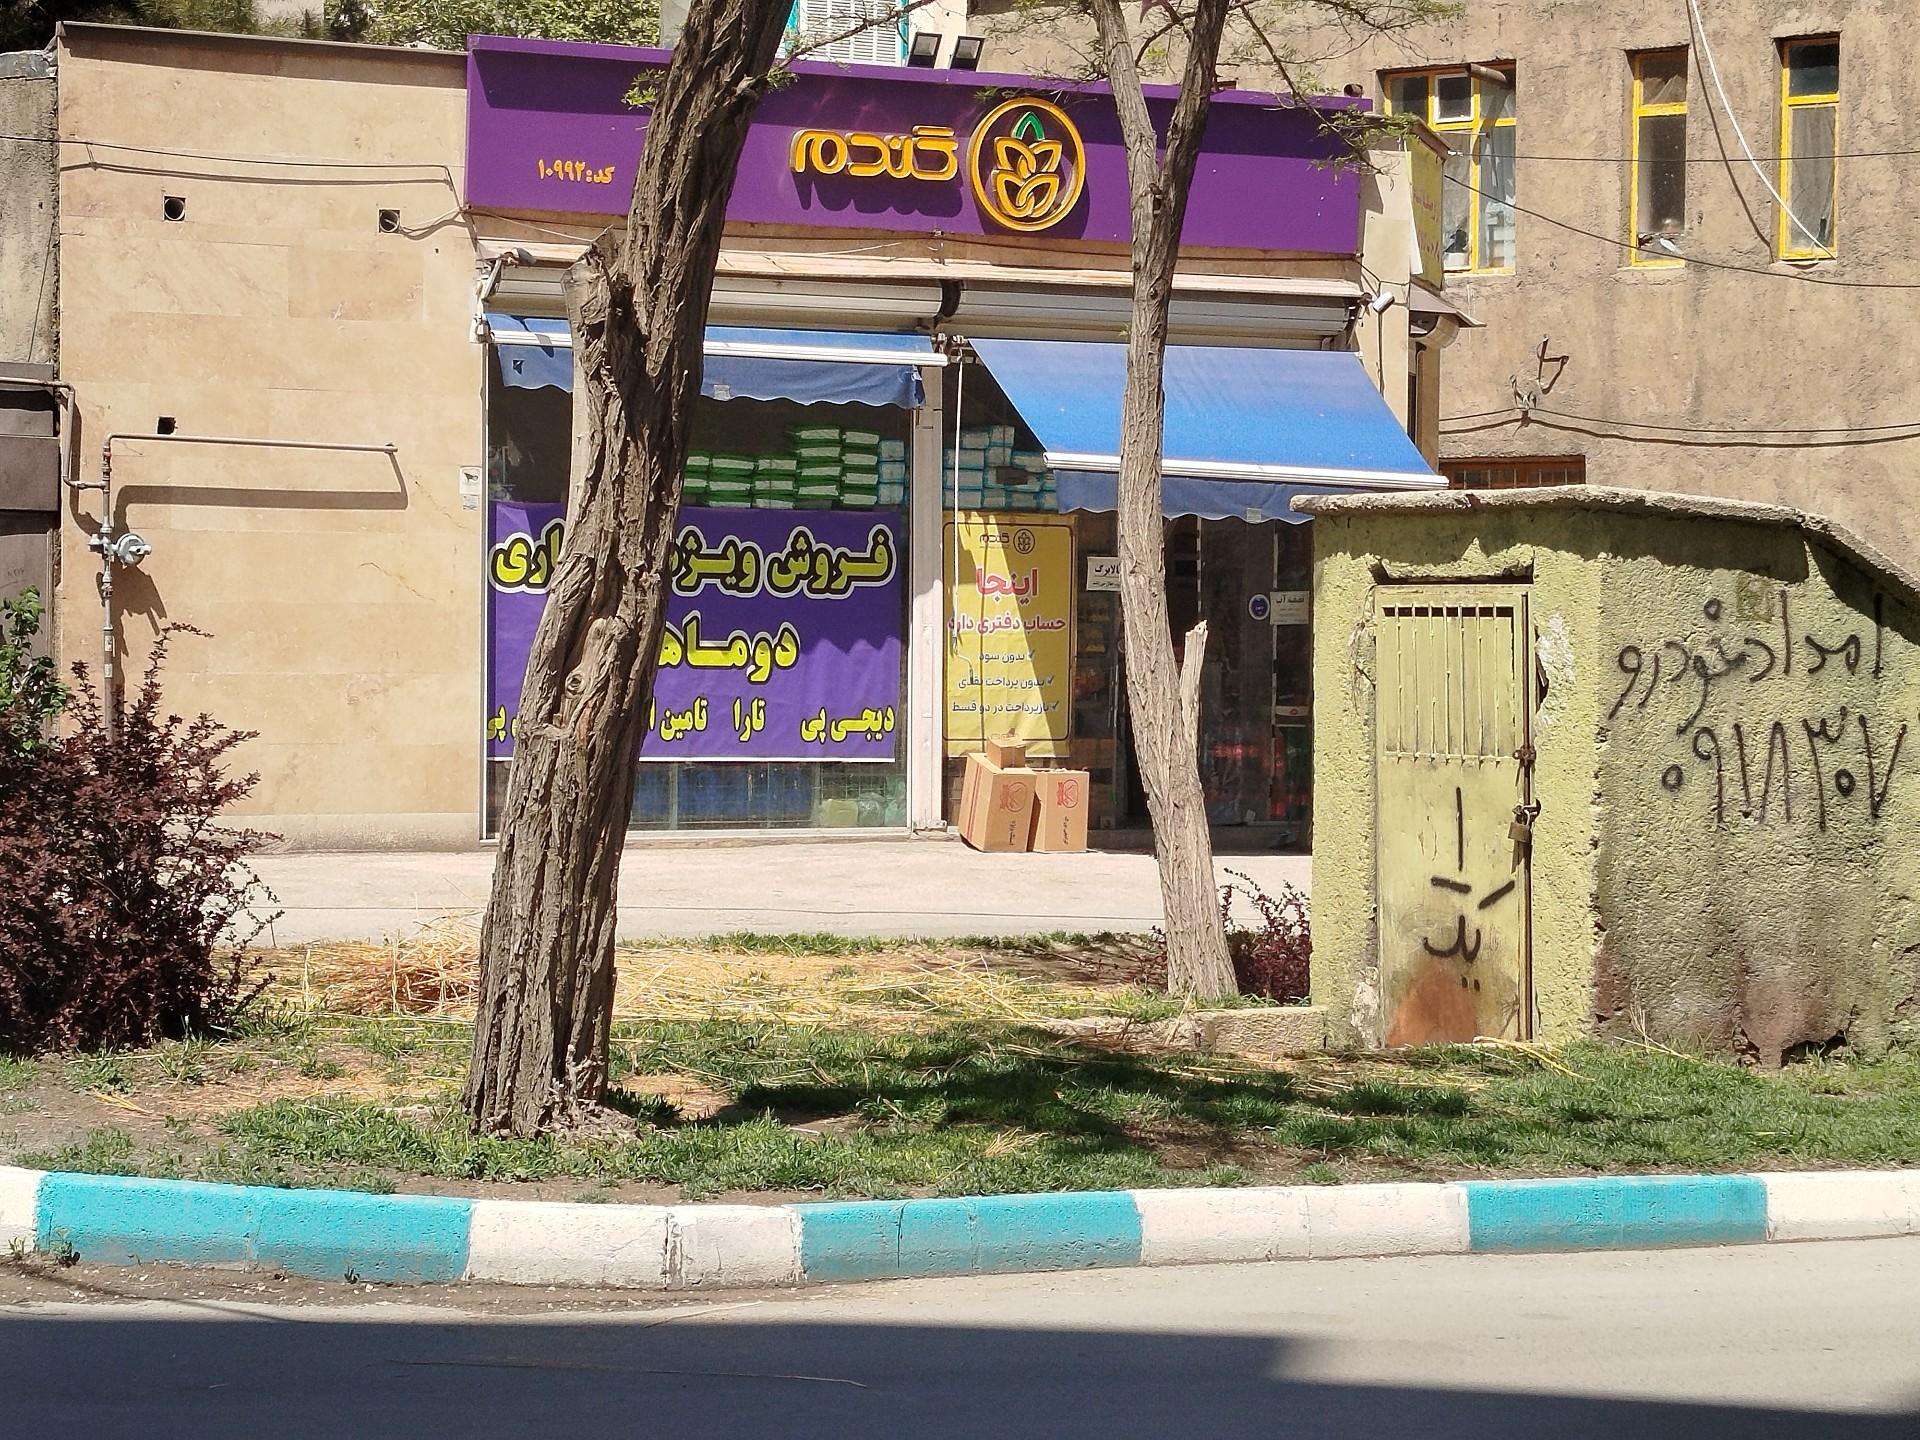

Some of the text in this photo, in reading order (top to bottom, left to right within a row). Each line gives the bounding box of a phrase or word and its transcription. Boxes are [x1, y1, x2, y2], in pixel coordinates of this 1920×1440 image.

[789, 124, 958, 181] گندم
[671, 524, 764, 598] ویژ
[766, 524, 897, 599] فروش
[975, 567, 1039, 605] اینجا
[977, 610, 1021, 634] دفتری
[1023, 614, 1067, 634] حساب
[979, 652, 1025, 664] بدون سود
[985, 676, 1019, 690] پرداخت
[659, 697, 709, 742] تامین
[732, 696, 768, 742] تارا
[829, 705, 896, 742] دیجی
[952, 700, 978, 712] قسط
[992, 702, 1004, 714] در
[800, 706, 828, 744] پی
